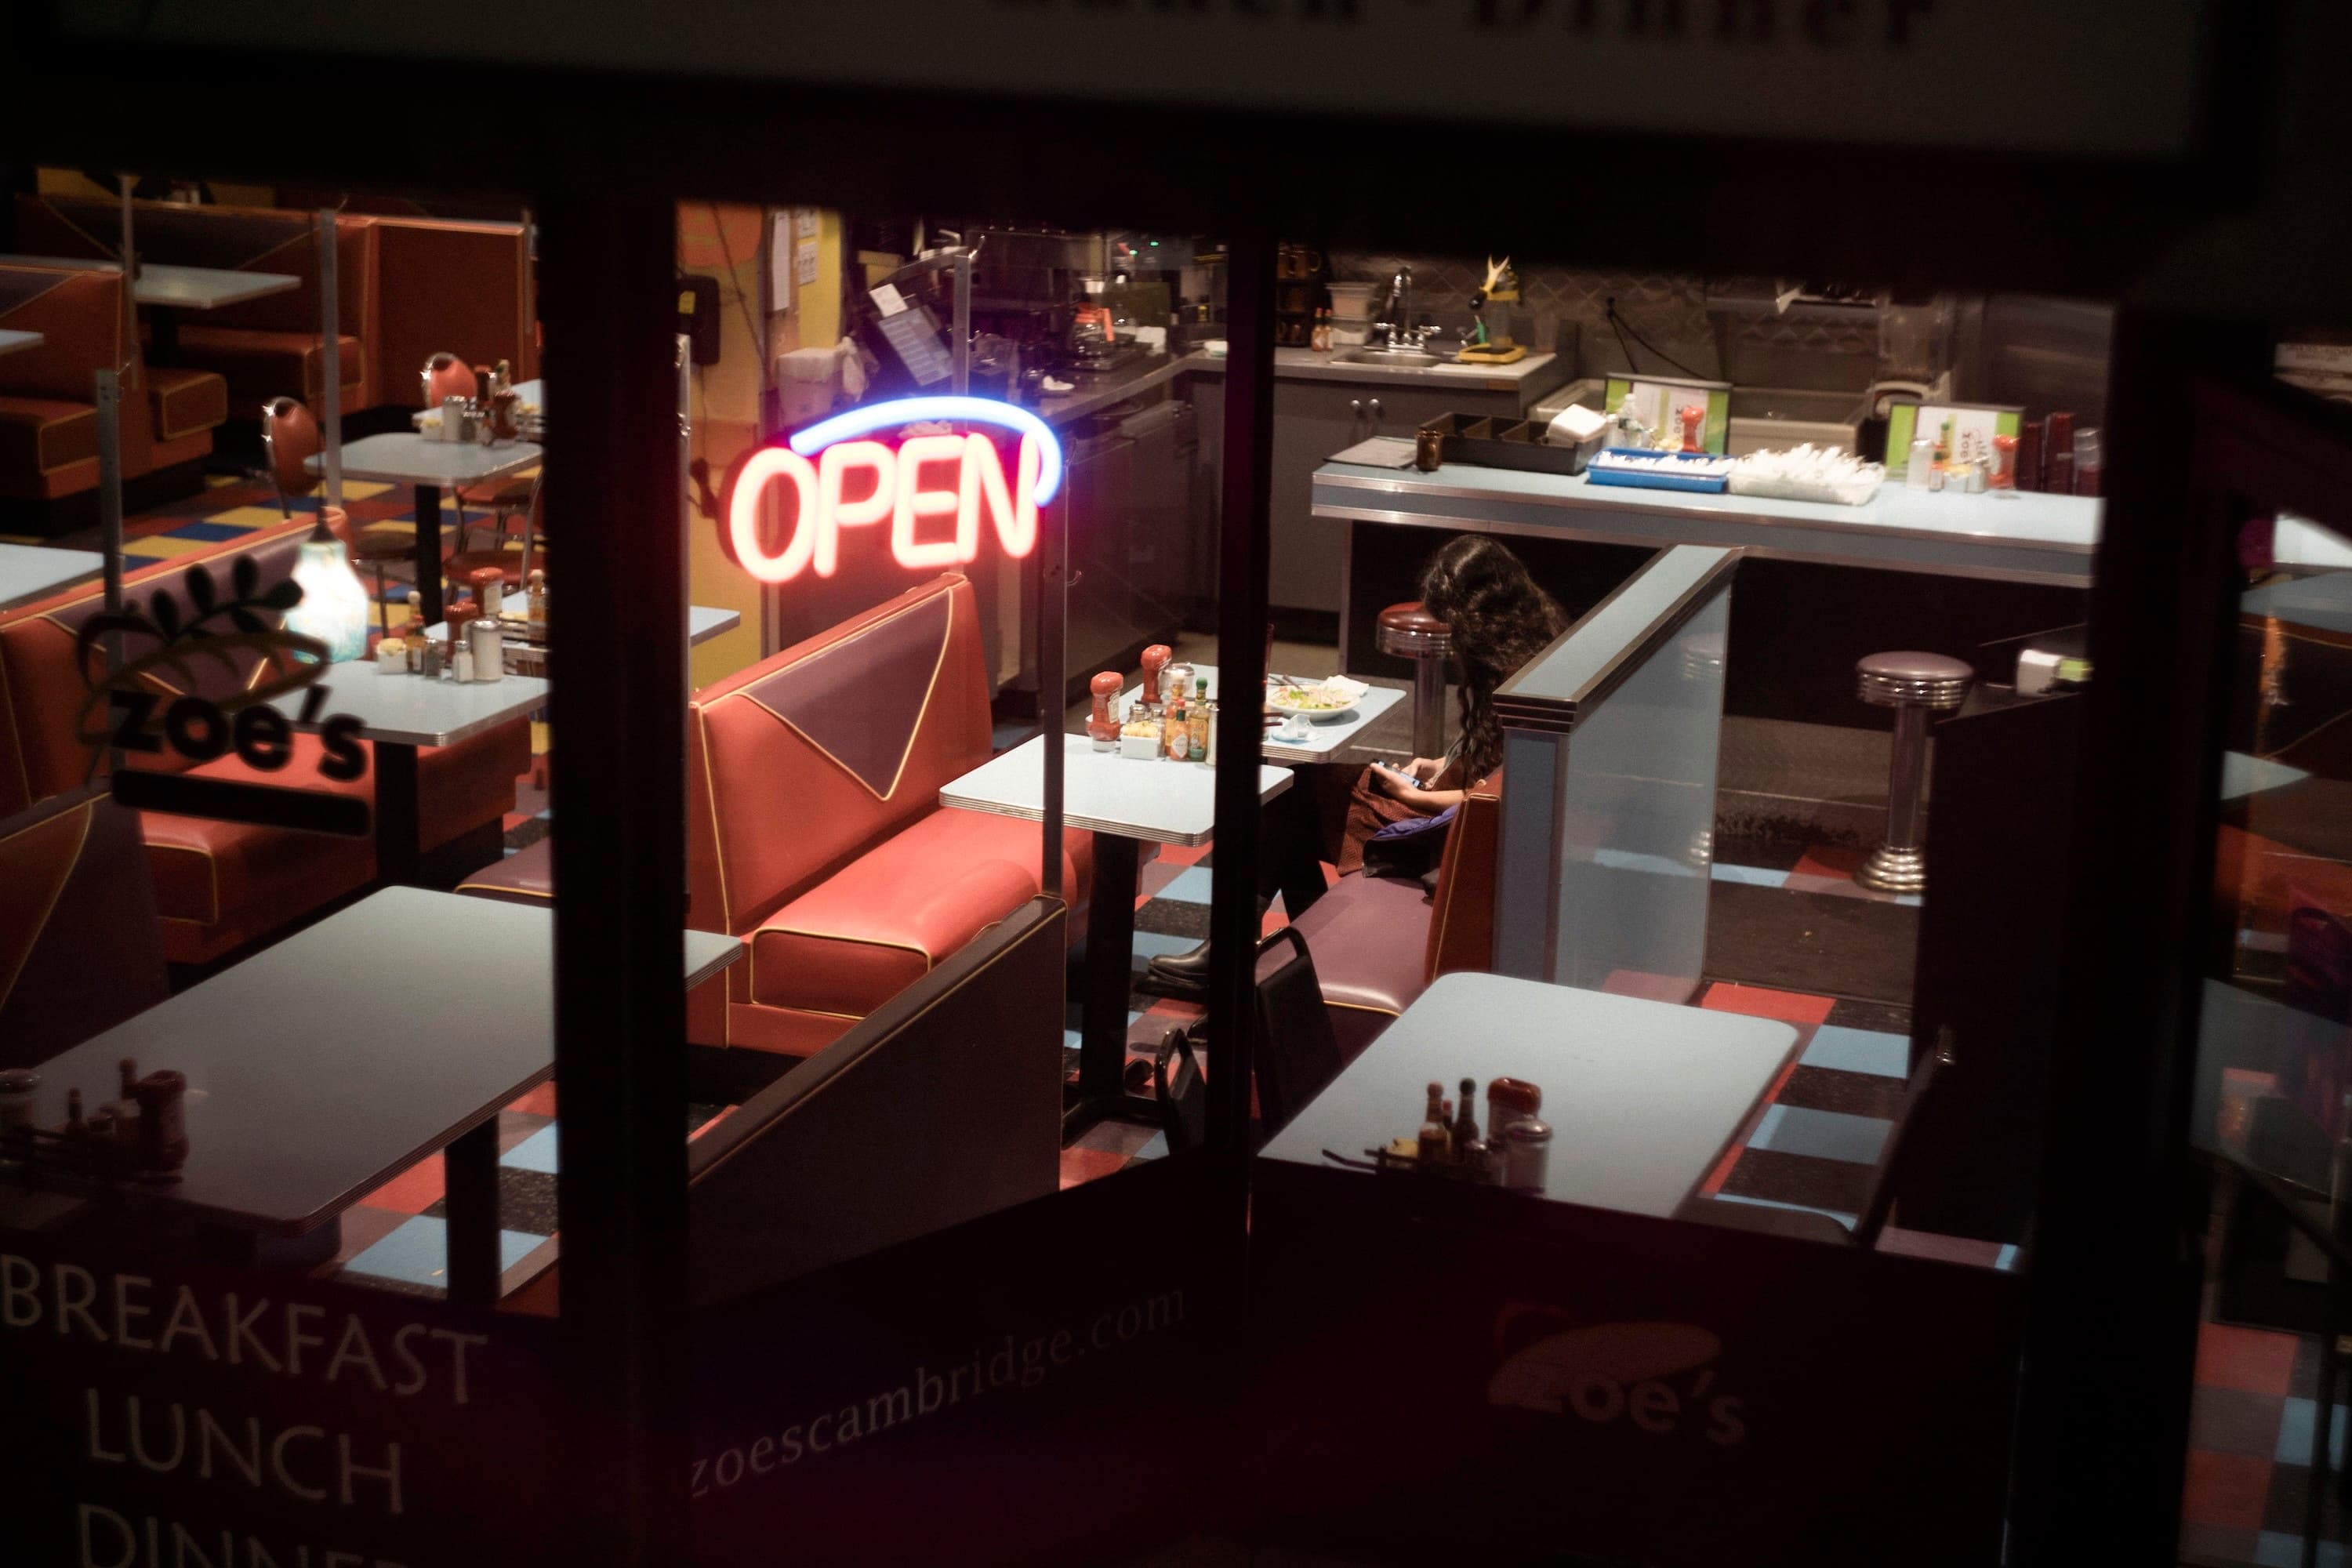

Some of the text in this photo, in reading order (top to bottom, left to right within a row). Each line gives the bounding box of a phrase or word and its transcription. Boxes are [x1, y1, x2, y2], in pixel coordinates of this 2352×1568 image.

[730, 431, 1038, 583] OPEN
[111, 683, 367, 782] zoe's
[1, 1254, 489, 1404] BREAKFAST
[690, 1287, 1187, 1497] zoescambridge.com
[83, 1385, 404, 1516] LUNCH
